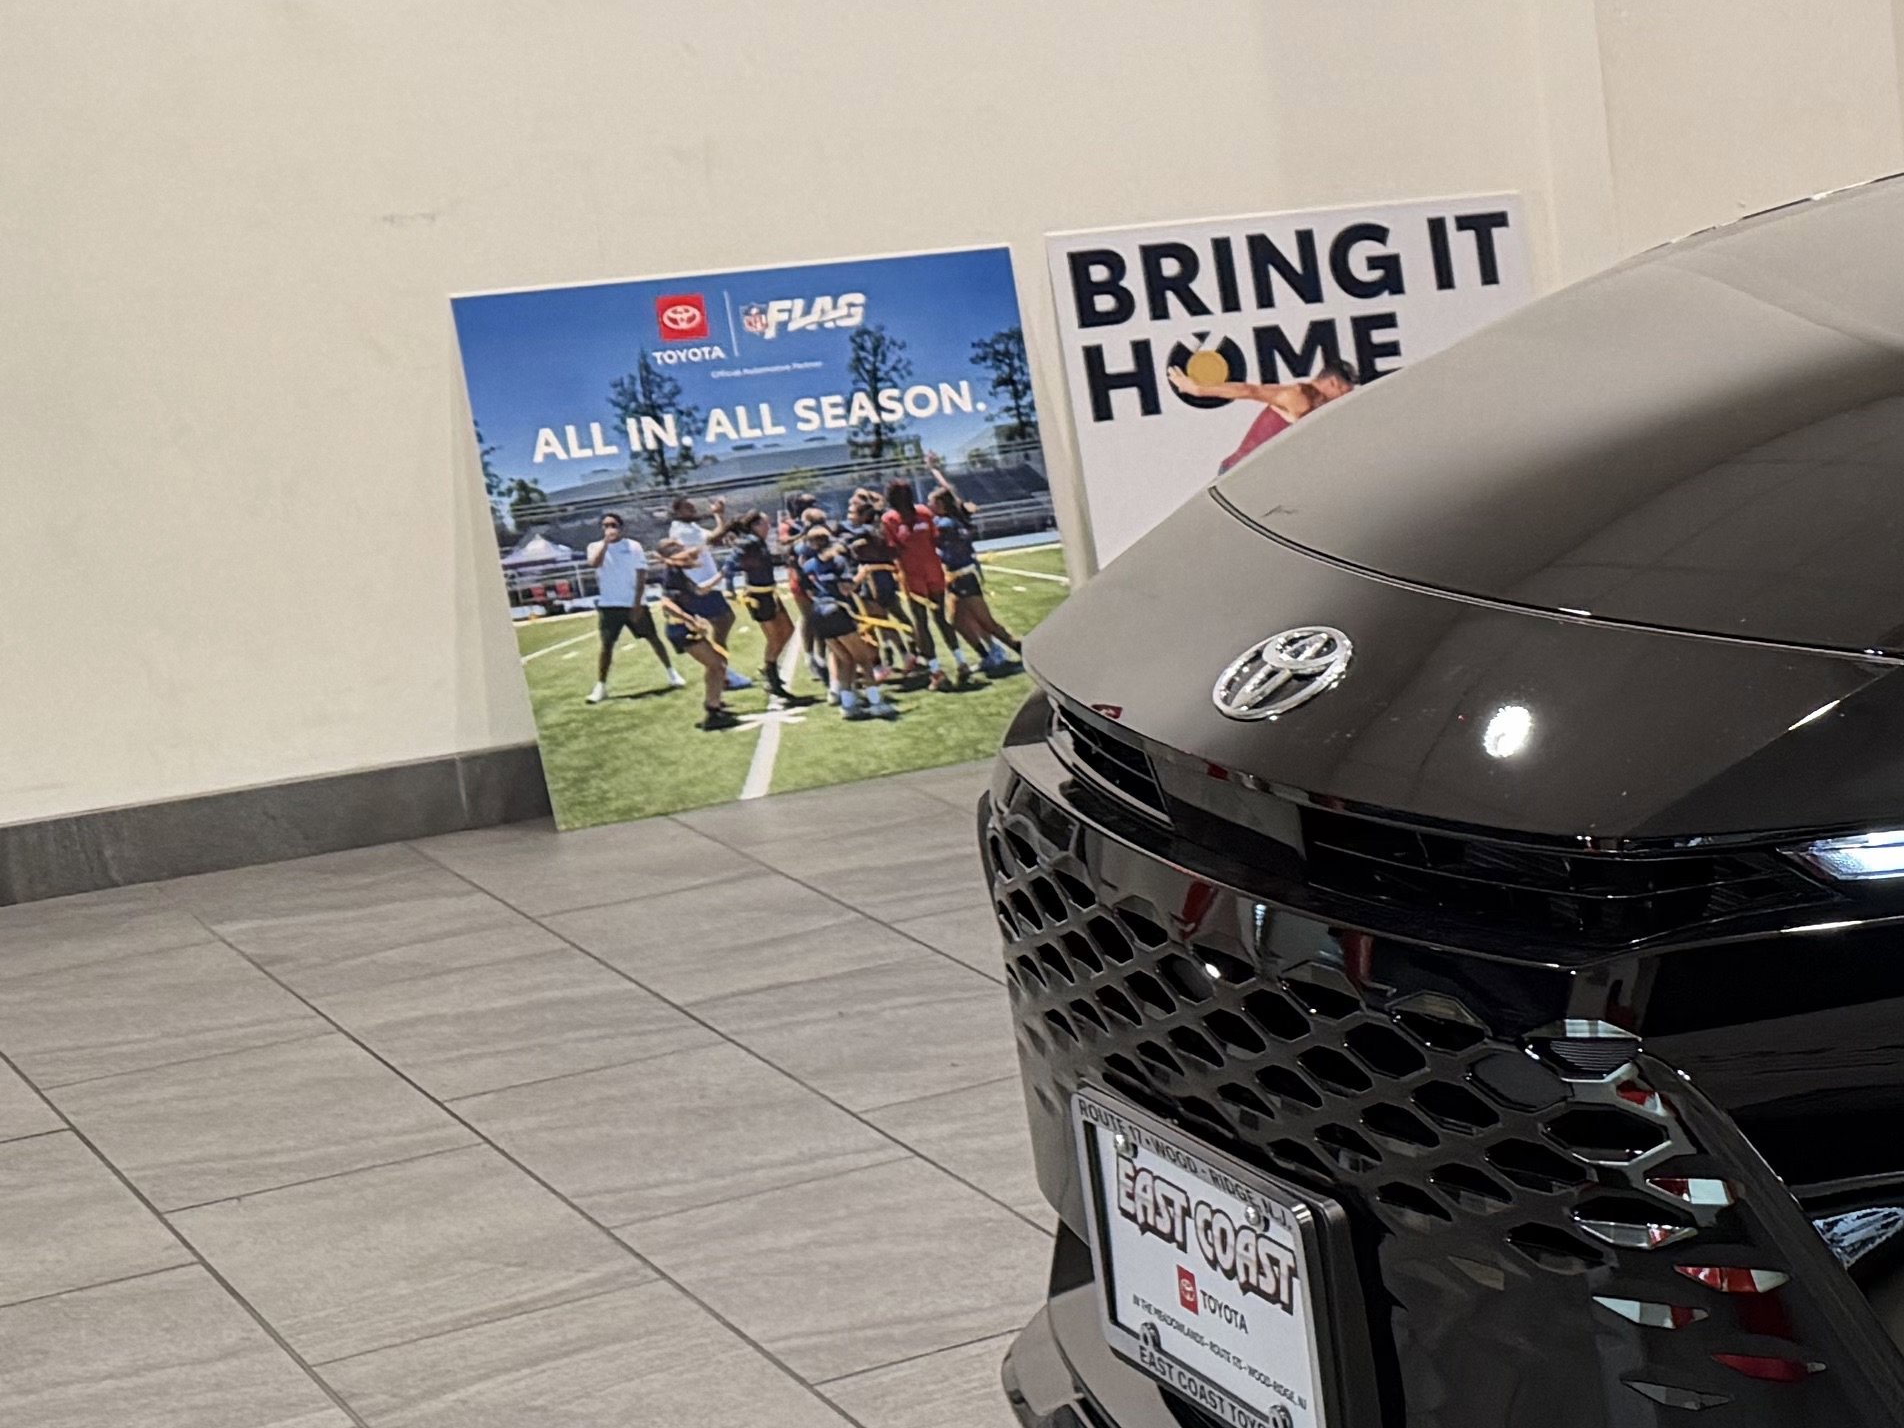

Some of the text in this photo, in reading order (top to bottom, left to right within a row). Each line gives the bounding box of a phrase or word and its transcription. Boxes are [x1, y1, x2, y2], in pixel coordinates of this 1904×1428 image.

[1066, 210, 1509, 330] BRING IT
[764, 292, 866, 339] FLAG
[652, 346, 725, 365] TOYOTA
[1081, 312, 1403, 423] HOME
[532, 380, 988, 464] ALL IN. ALL SEASON.
[1078, 1098, 1127, 1136] ROUTE
[1128, 1124, 1142, 1145] 17
[1154, 1136, 1198, 1174] WOOD
[1116, 1153, 1299, 1316] EAST COAST
[1199, 1289, 1249, 1335] TOYOTA
[1139, 1345, 1174, 1380] EAST
[1178, 1370, 1224, 1410] COAST
